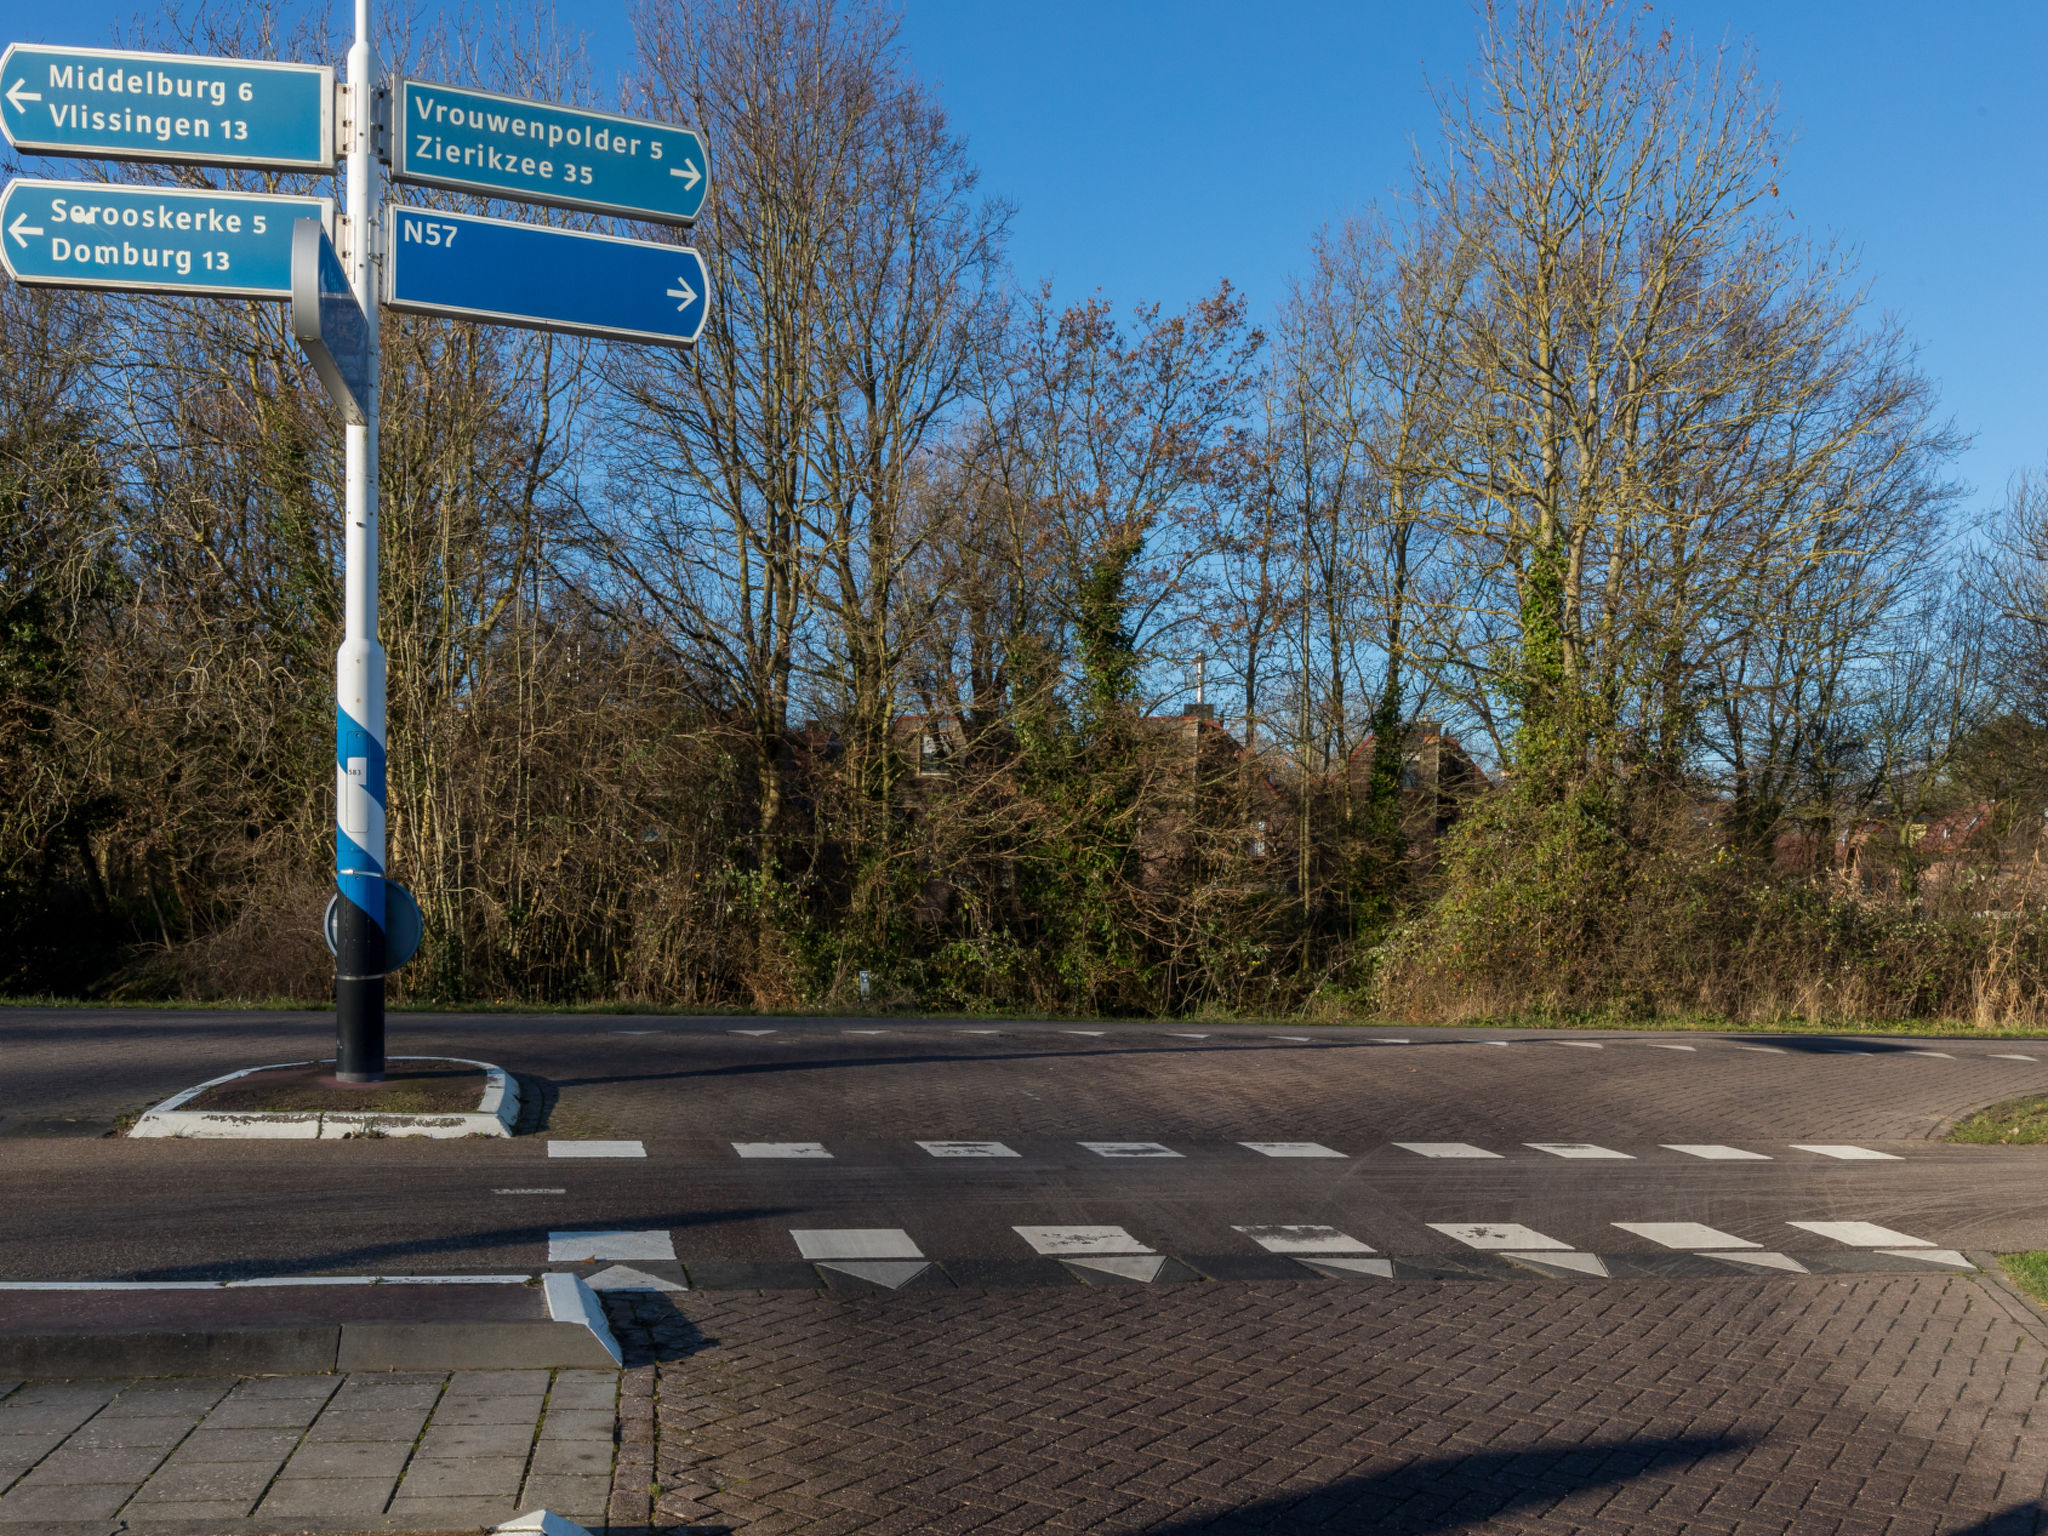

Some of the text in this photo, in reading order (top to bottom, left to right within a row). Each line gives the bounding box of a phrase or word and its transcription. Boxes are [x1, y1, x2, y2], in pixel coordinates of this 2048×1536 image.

[49, 63, 254, 107] Middelburg 6
[48, 103, 249, 142] Vlissingen 13
[415, 96, 663, 160] Vrouwenpolder 5
[415, 134, 593, 185] Zierikzee 35
[50, 198, 267, 235] Serooskerke 5
[403, 219, 458, 248] N57
[51, 237, 230, 275] Domburg 13
